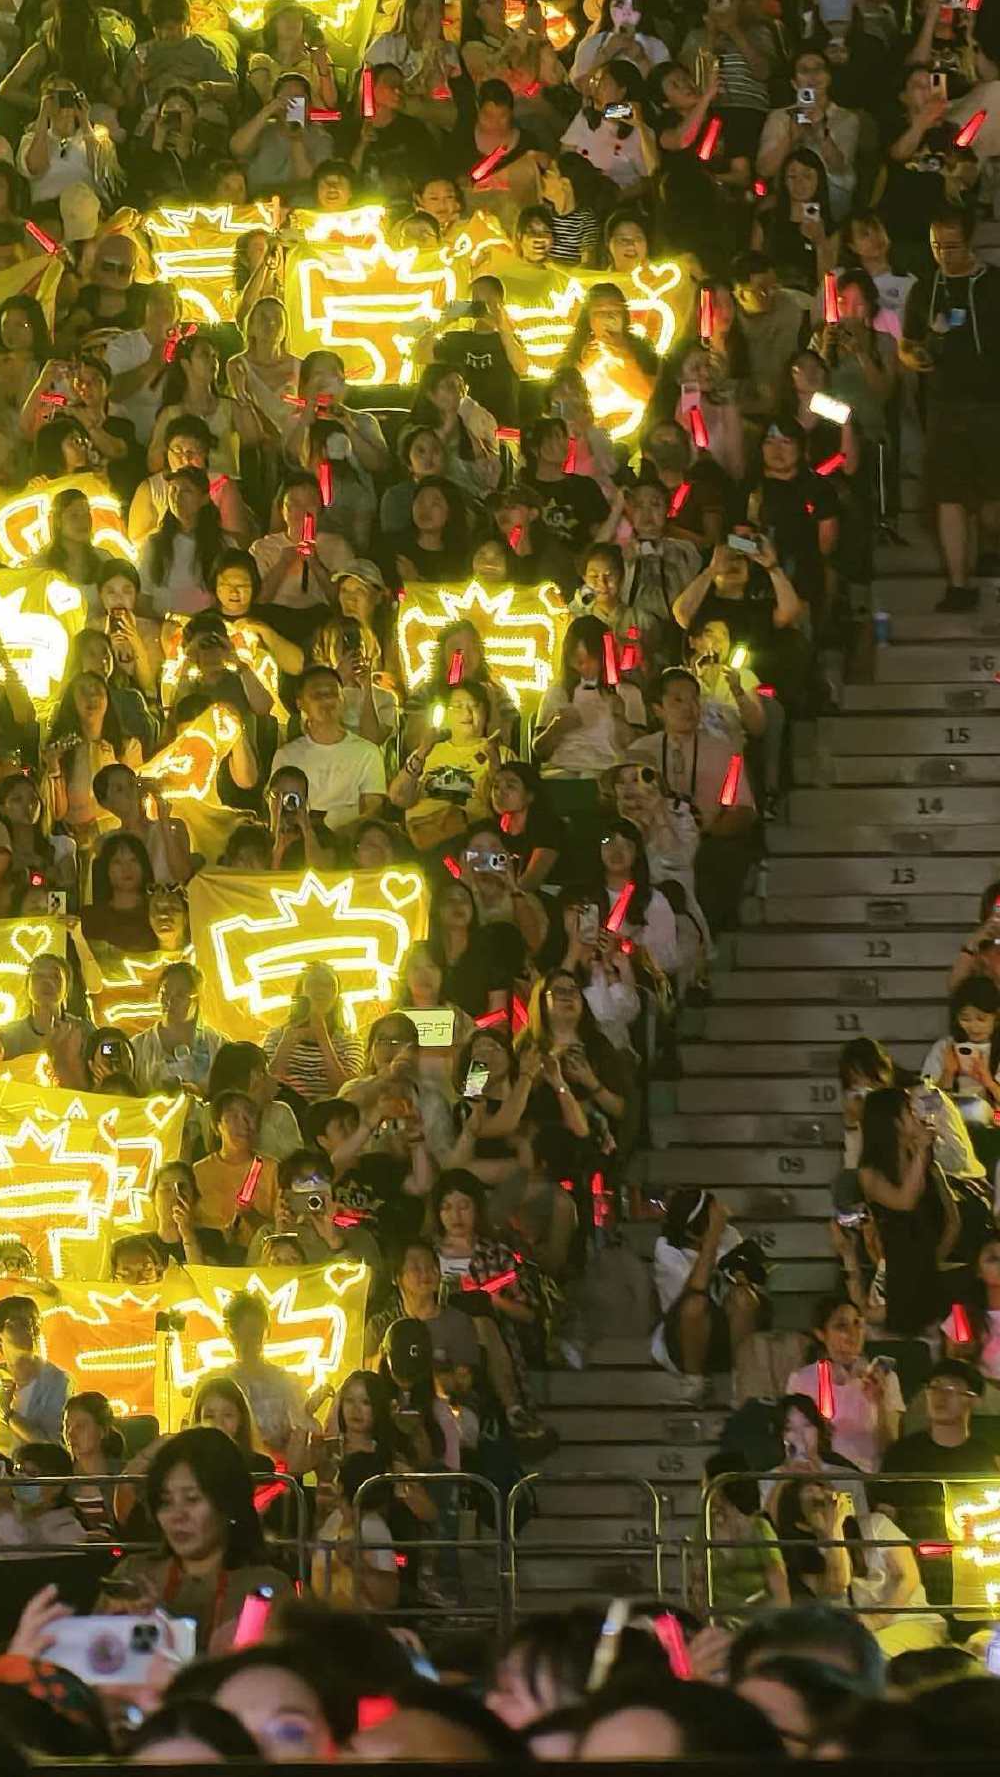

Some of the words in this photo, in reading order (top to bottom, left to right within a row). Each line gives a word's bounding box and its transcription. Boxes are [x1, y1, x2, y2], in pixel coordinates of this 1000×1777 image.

[945, 728, 970, 743] 15
[918, 797, 944, 814] 14
[891, 867, 916, 884] 13
[865, 941, 892, 958] 12
[836, 1014, 860, 1030] 11
[810, 1086, 836, 1101] 10
